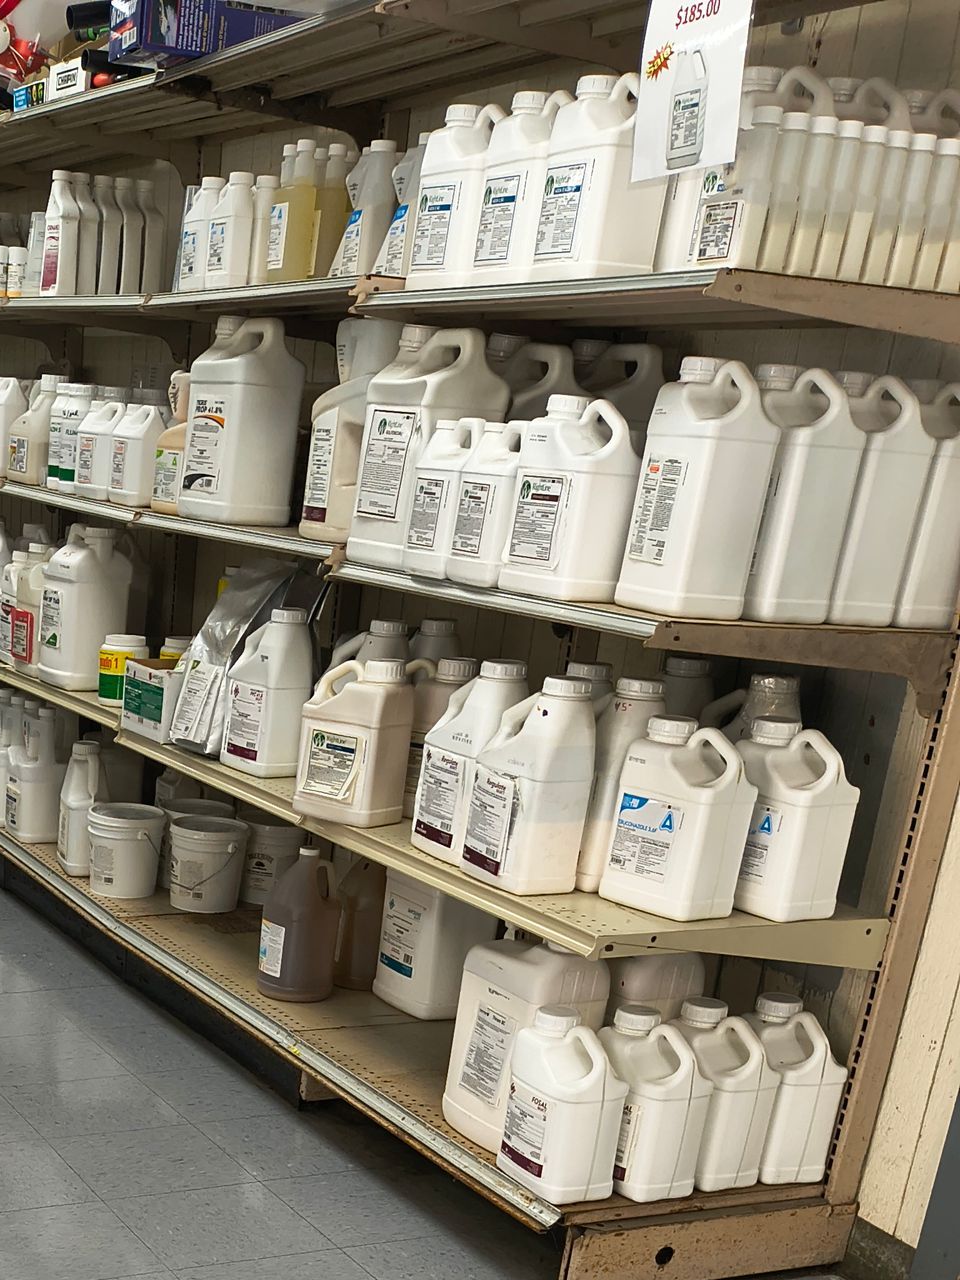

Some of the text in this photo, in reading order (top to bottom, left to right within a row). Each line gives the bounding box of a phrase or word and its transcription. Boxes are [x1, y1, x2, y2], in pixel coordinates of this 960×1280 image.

[675, 0, 720, 30] $185.00
[441, 755, 458, 767] Regulate
[486, 778, 507, 791] Regulate
[532, 1096, 547, 1109] FOSAL
